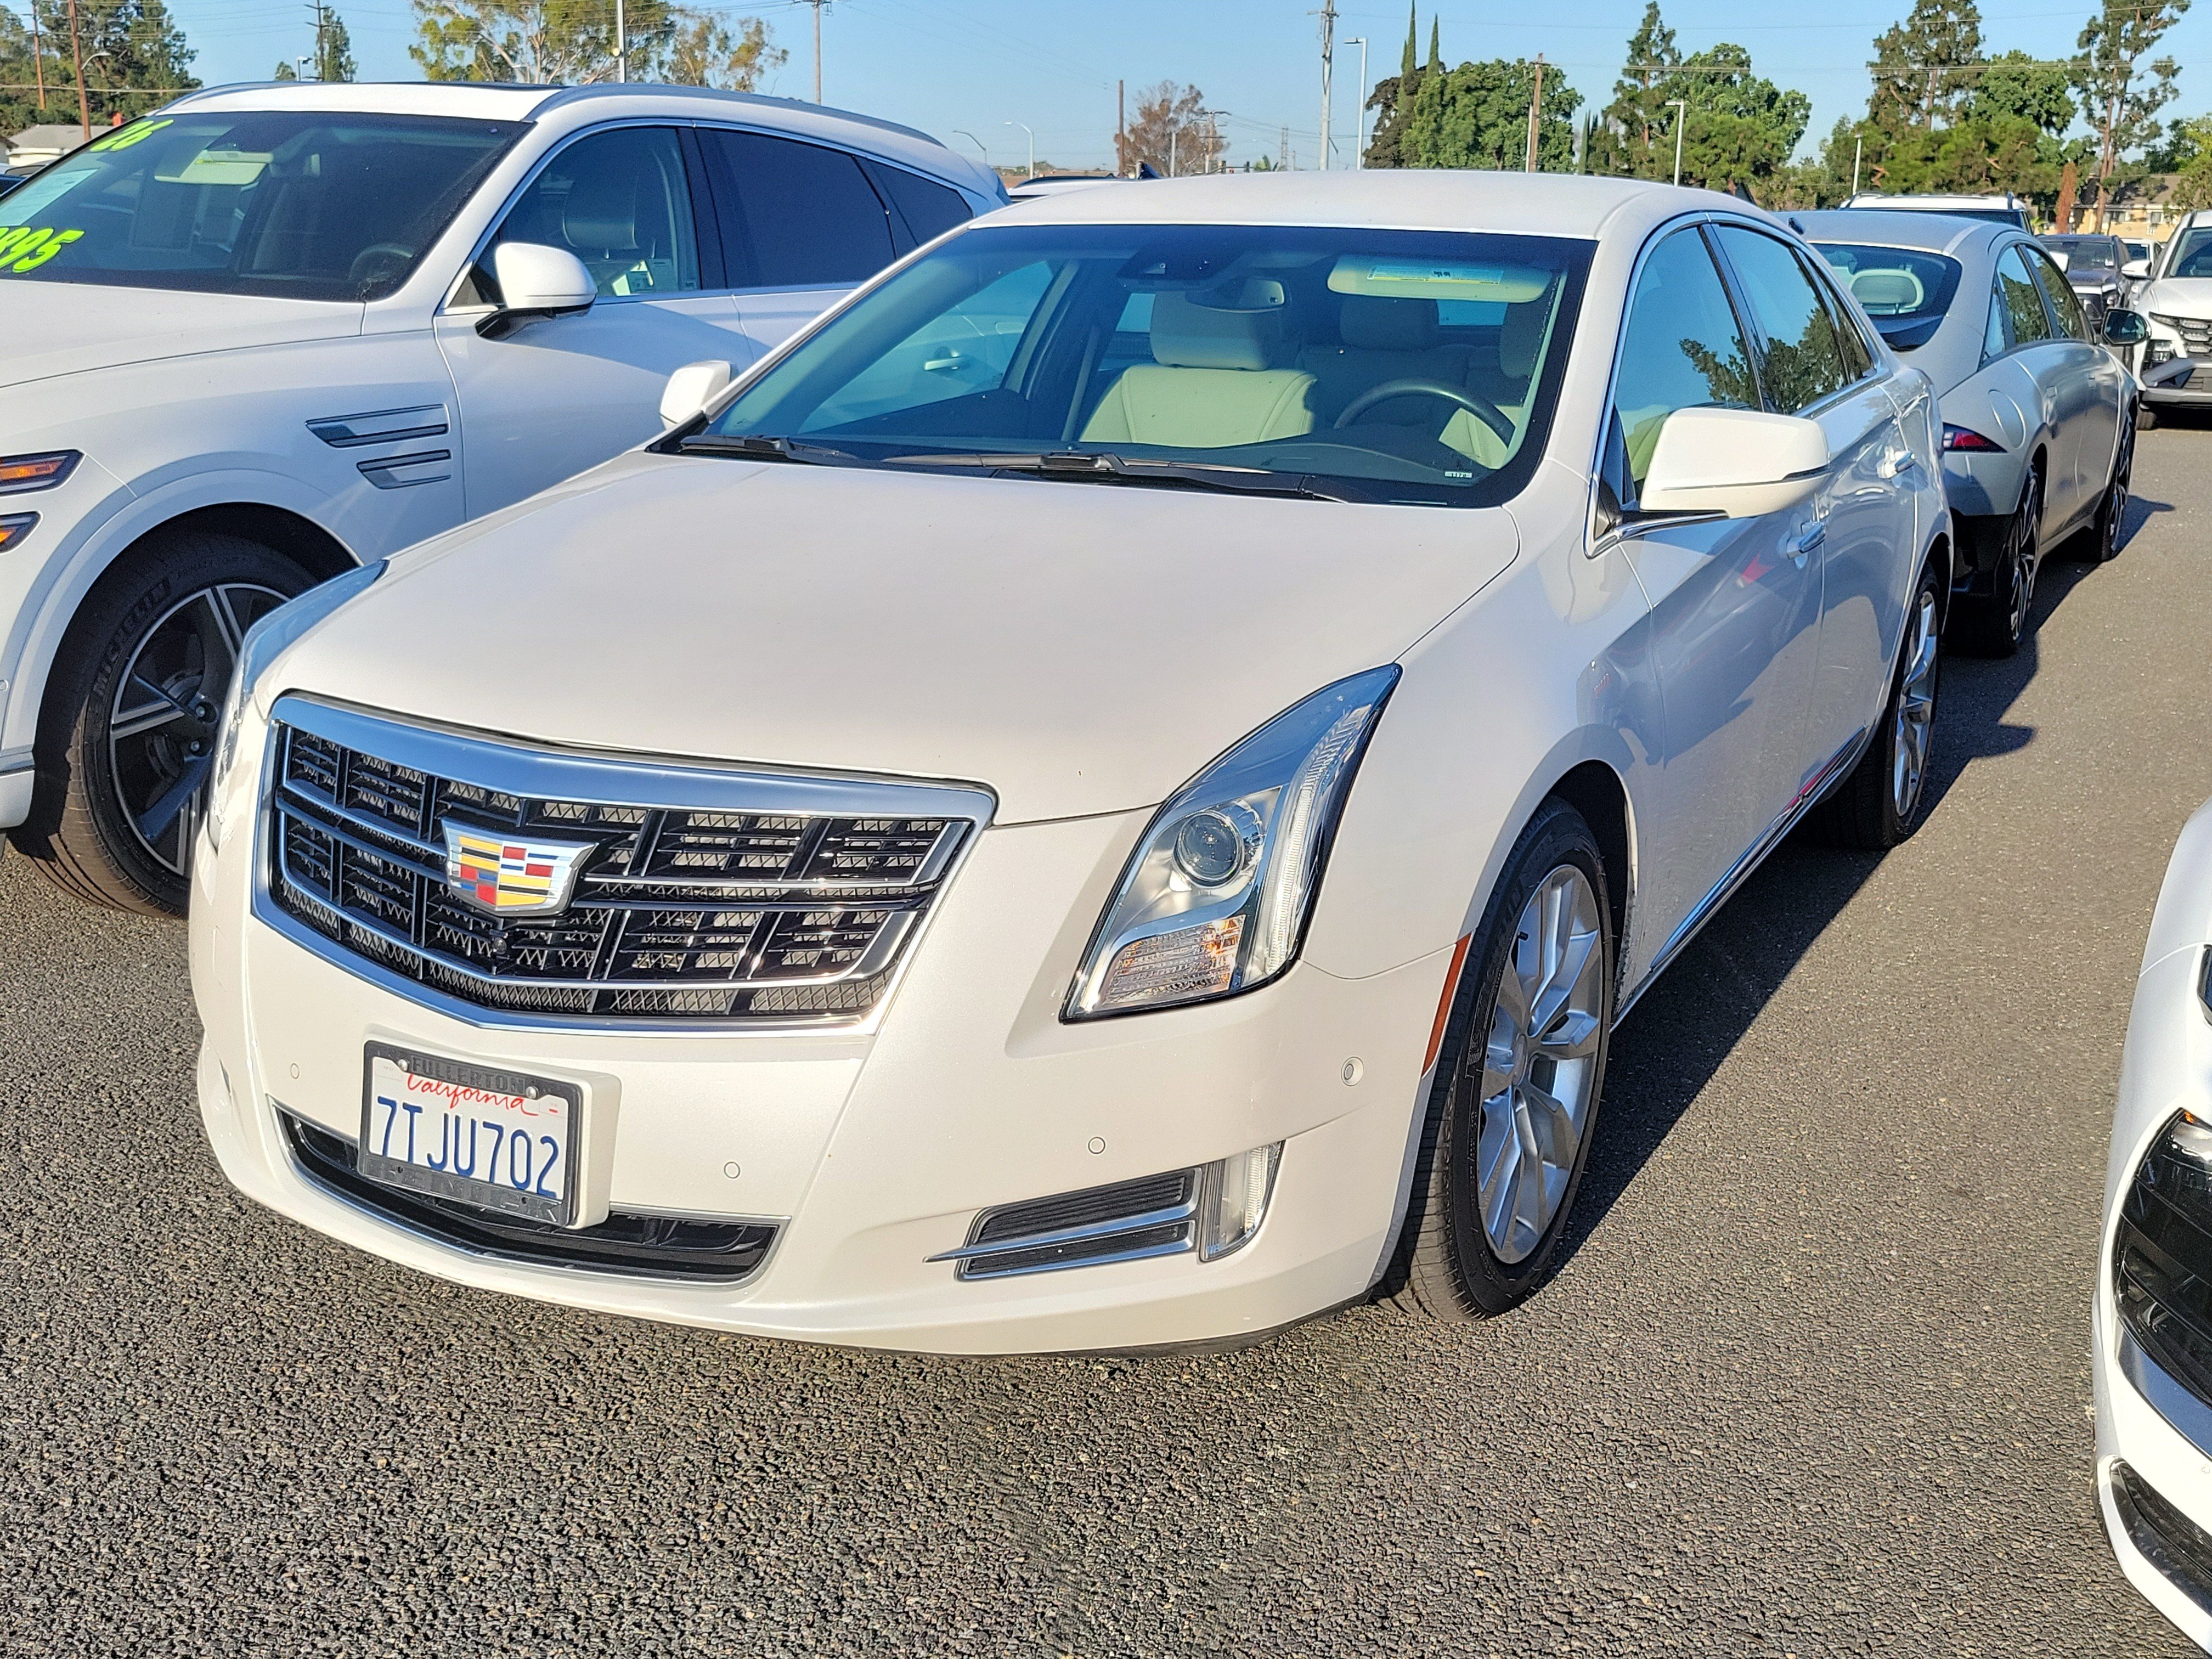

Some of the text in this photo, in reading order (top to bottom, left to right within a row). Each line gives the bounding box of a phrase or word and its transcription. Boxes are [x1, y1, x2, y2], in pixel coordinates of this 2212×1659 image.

[89, 119, 174, 152] 26
[92, 578, 167, 697] MICHELIN
[407, 1073, 539, 1116] California
[412, 1054, 526, 1096] FULLERTON
[377, 1095, 558, 1199] 7TJU702
